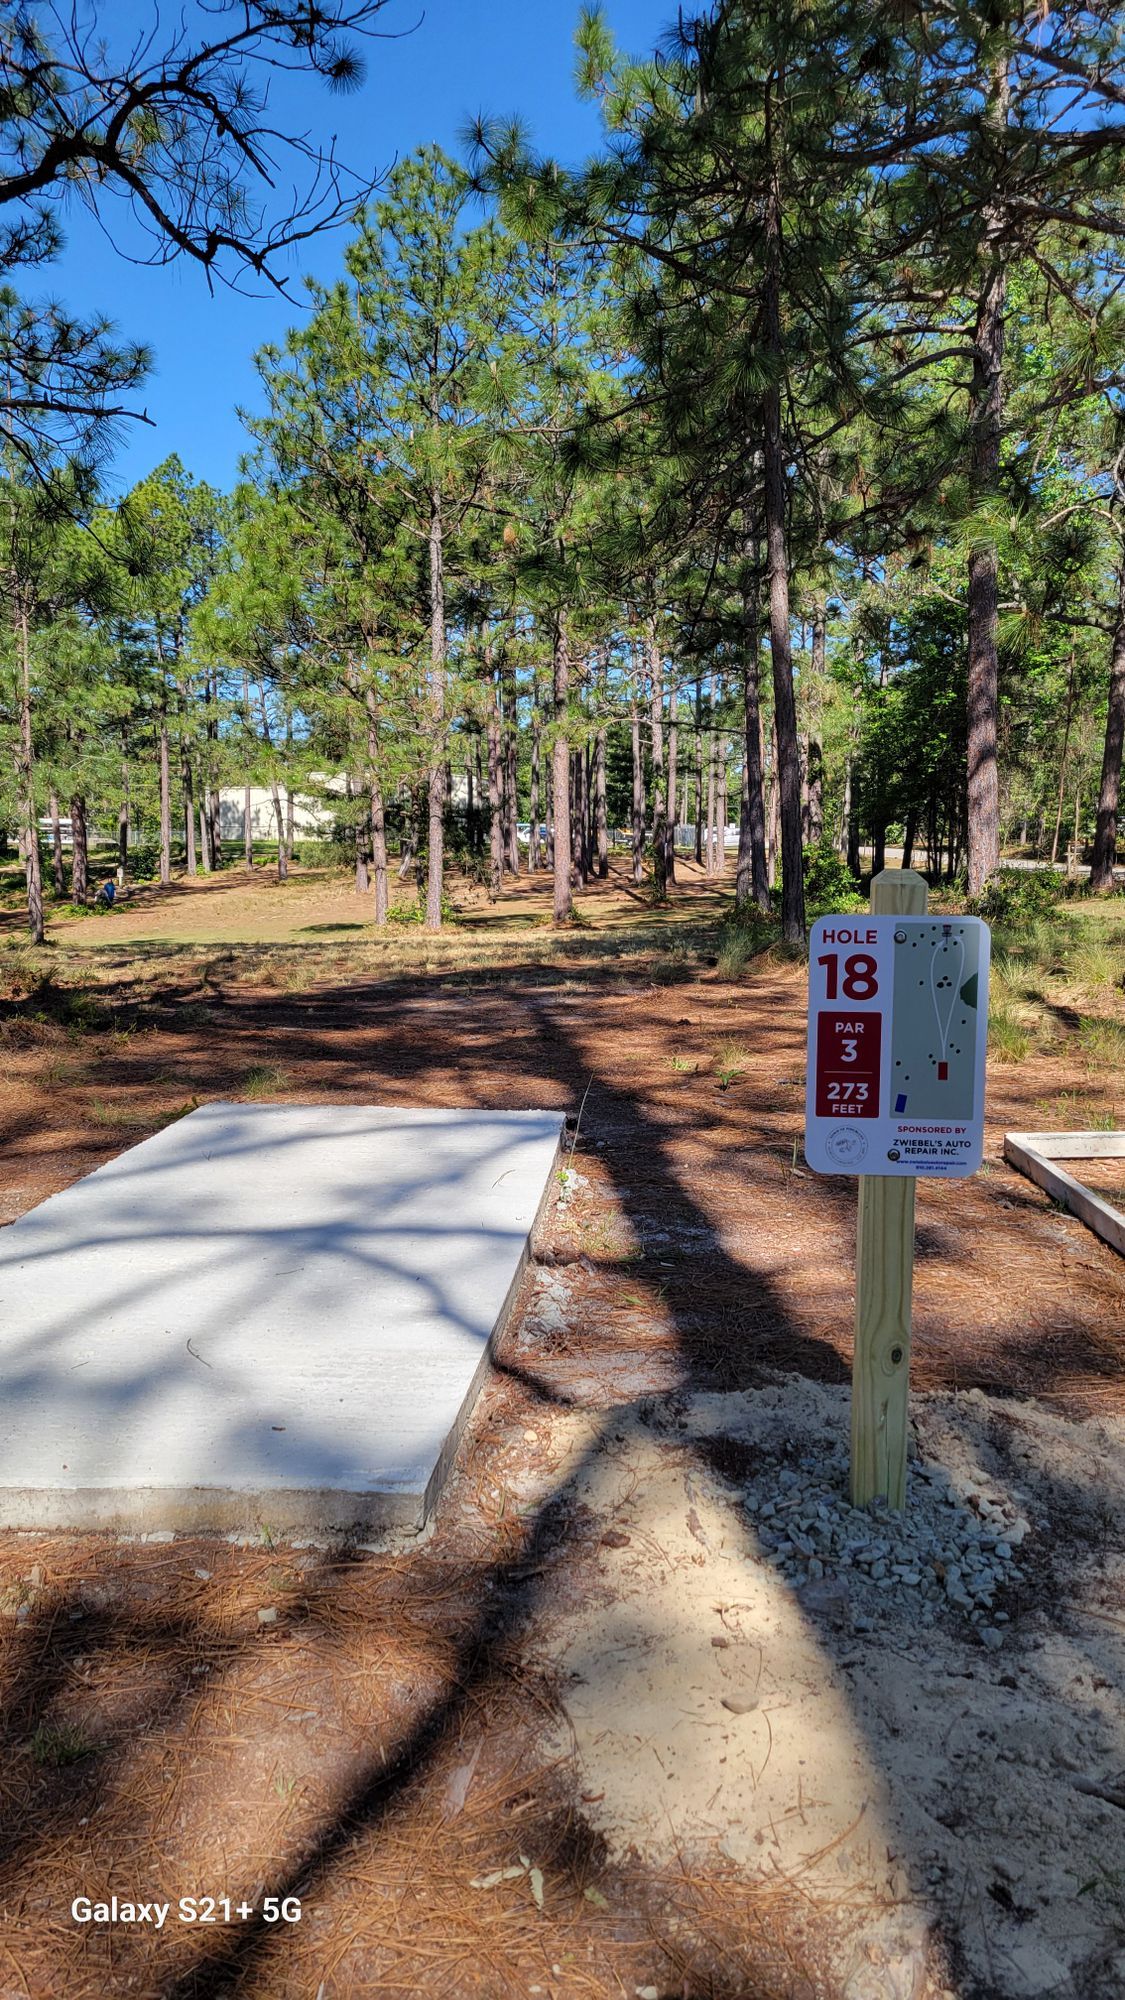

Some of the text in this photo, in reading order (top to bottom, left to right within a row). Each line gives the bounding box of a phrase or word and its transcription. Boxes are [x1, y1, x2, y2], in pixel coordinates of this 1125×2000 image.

[822, 929, 878, 945] HOLE
[817, 953, 879, 1001] 18
[834, 1022, 865, 1034] PAR
[840, 1039, 858, 1062] 3
[826, 1082, 869, 1101] 273
[831, 1103, 864, 1114] FEET
[897, 1125, 953, 1134] SPONSORED
[892, 1139, 972, 1148] ZWIEBEL'S AUTO
[904, 1147, 960, 1156] REPAIR INC.
